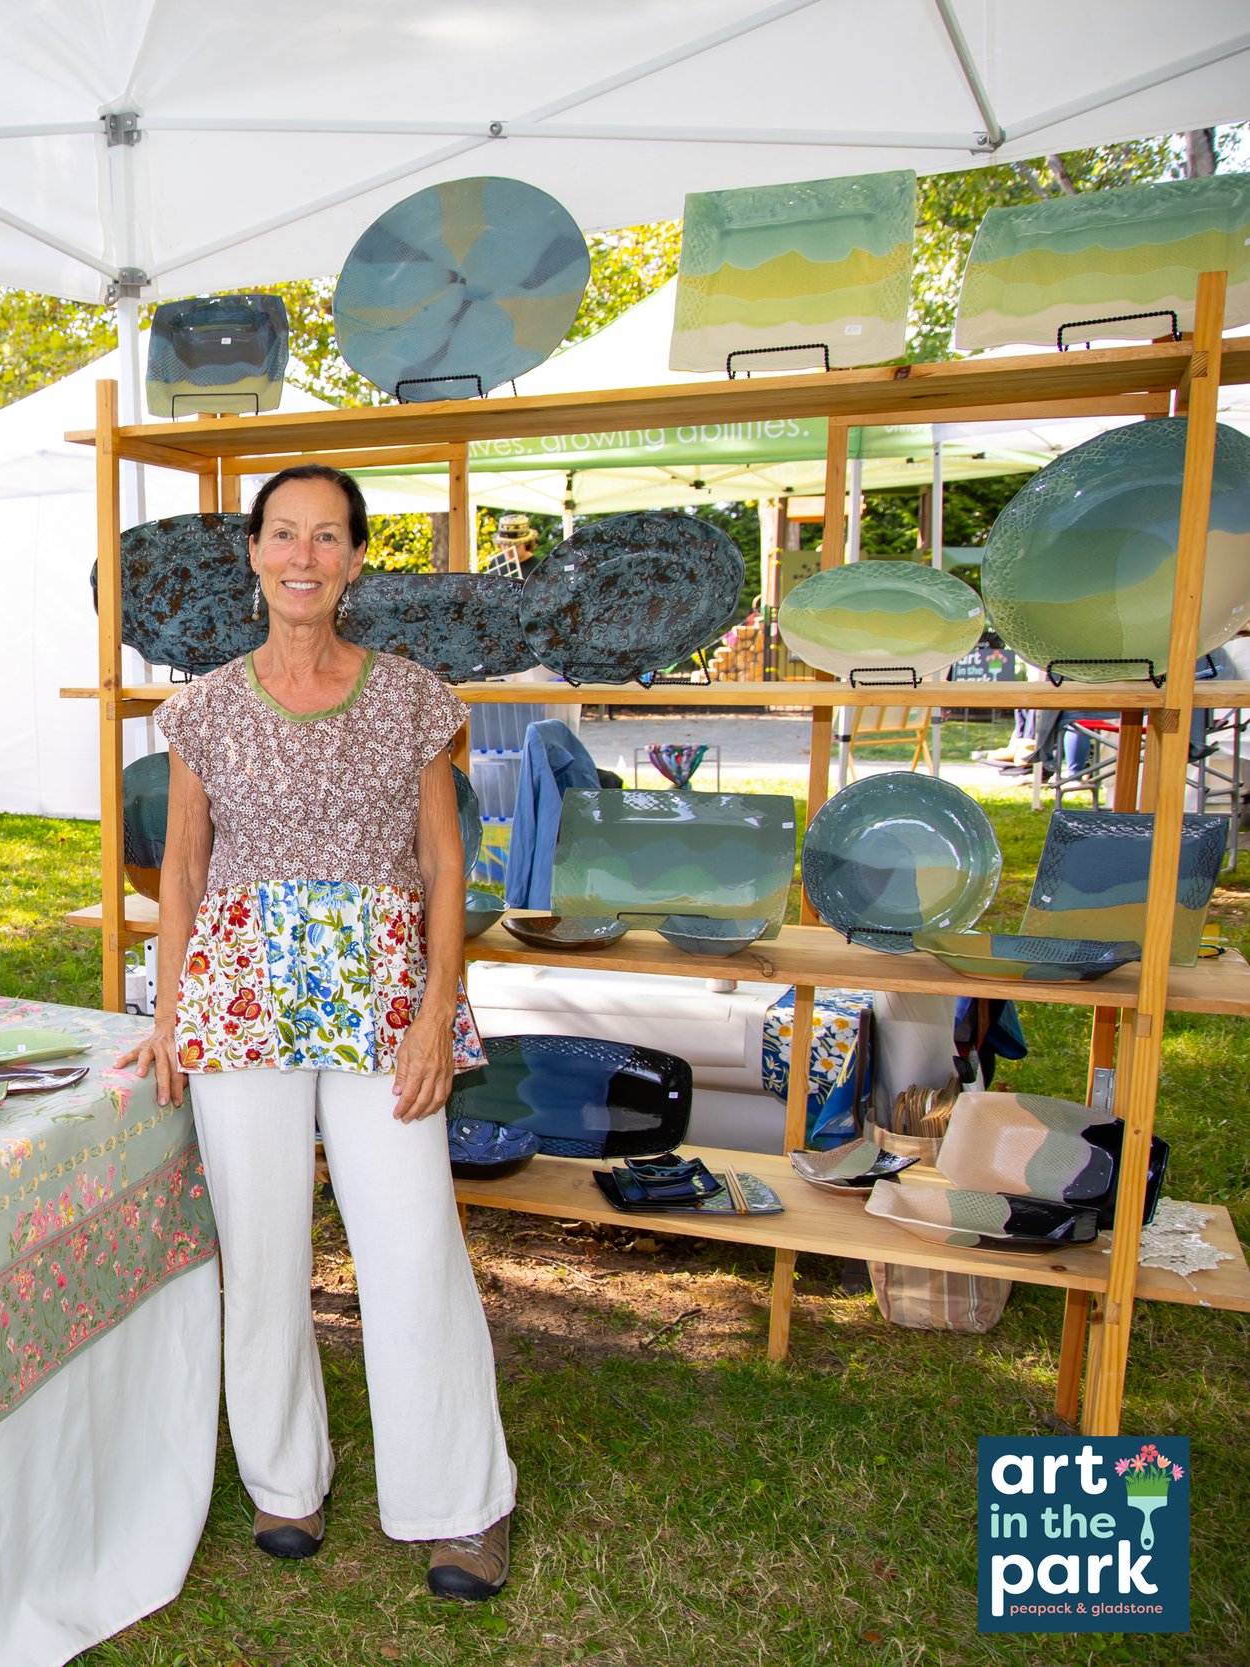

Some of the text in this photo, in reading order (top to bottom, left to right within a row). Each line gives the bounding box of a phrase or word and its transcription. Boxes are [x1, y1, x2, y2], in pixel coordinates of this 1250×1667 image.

[541, 426, 665, 455] growing
[957, 665, 984, 675] in the
